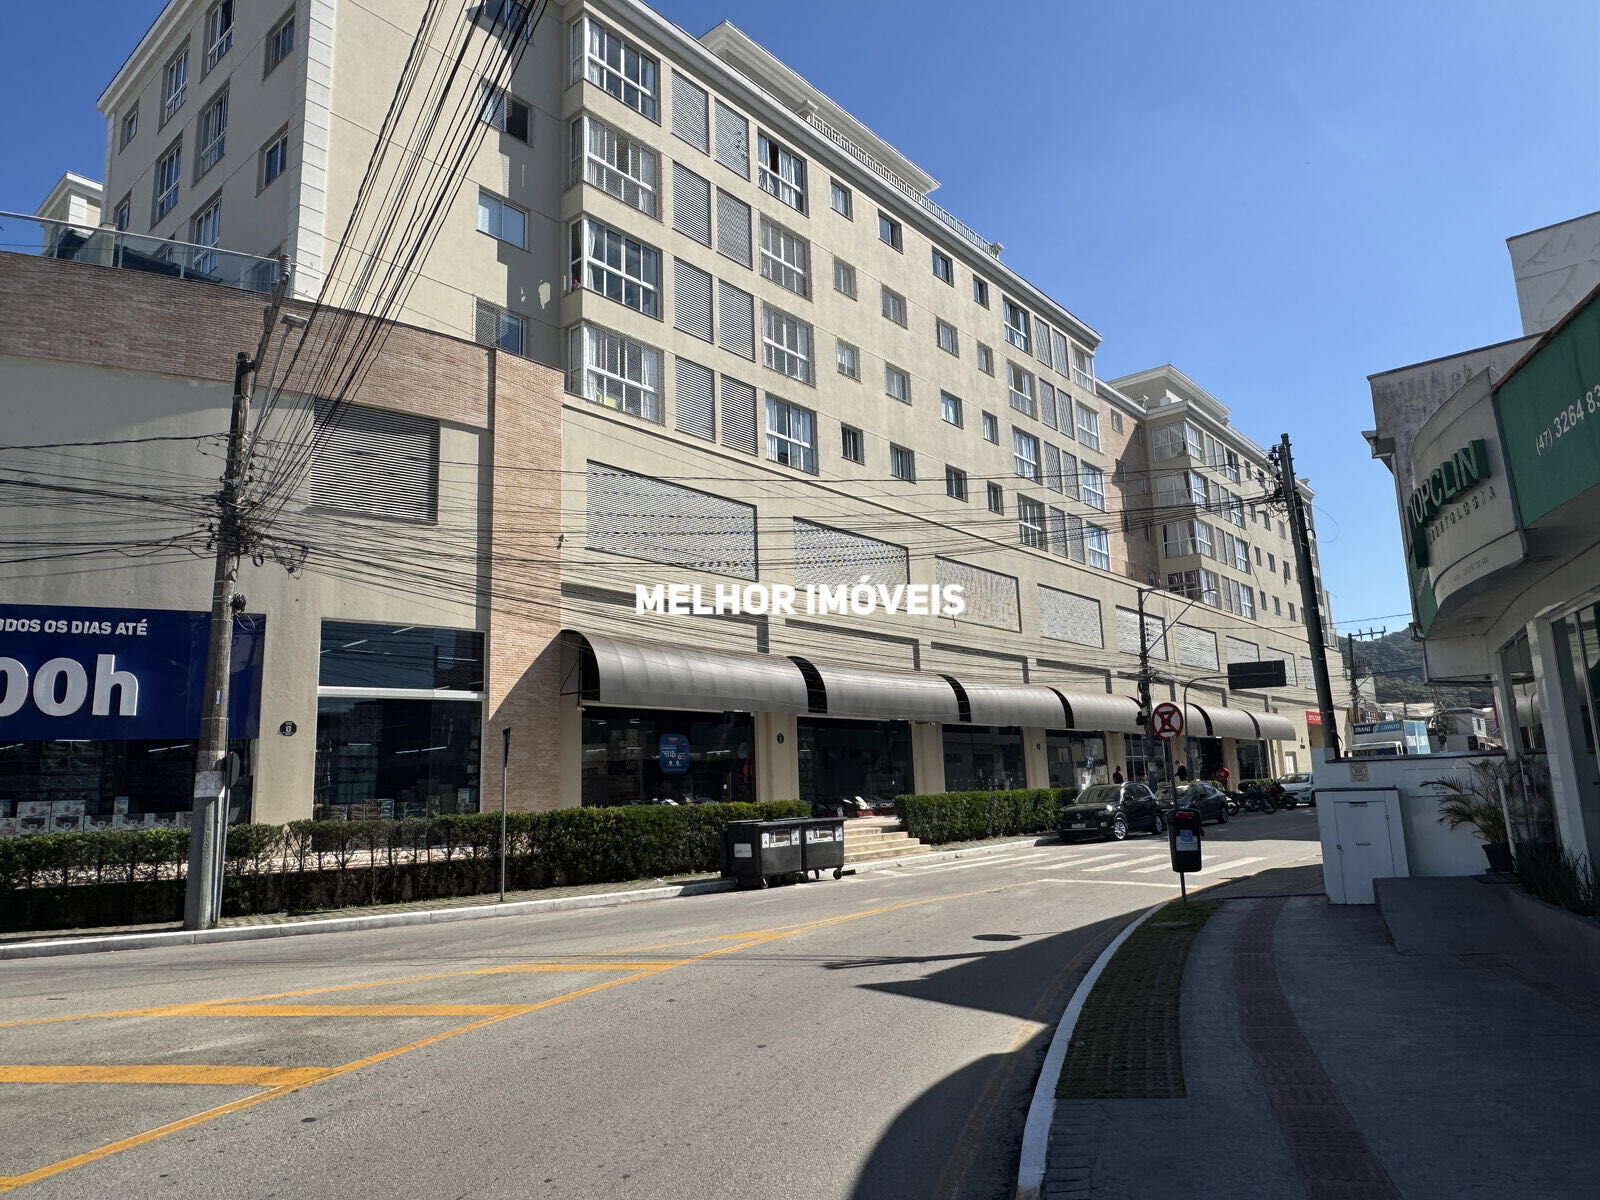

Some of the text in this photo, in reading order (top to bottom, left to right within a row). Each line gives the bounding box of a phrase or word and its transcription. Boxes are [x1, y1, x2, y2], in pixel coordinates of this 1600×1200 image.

[1535, 427, 1553, 456] (47)
[1553, 399, 1585, 438] 3264
[44, 620, 68, 633] OS
[71, 621, 112, 635] DIAS
[115, 619, 148, 636] ATÉ
